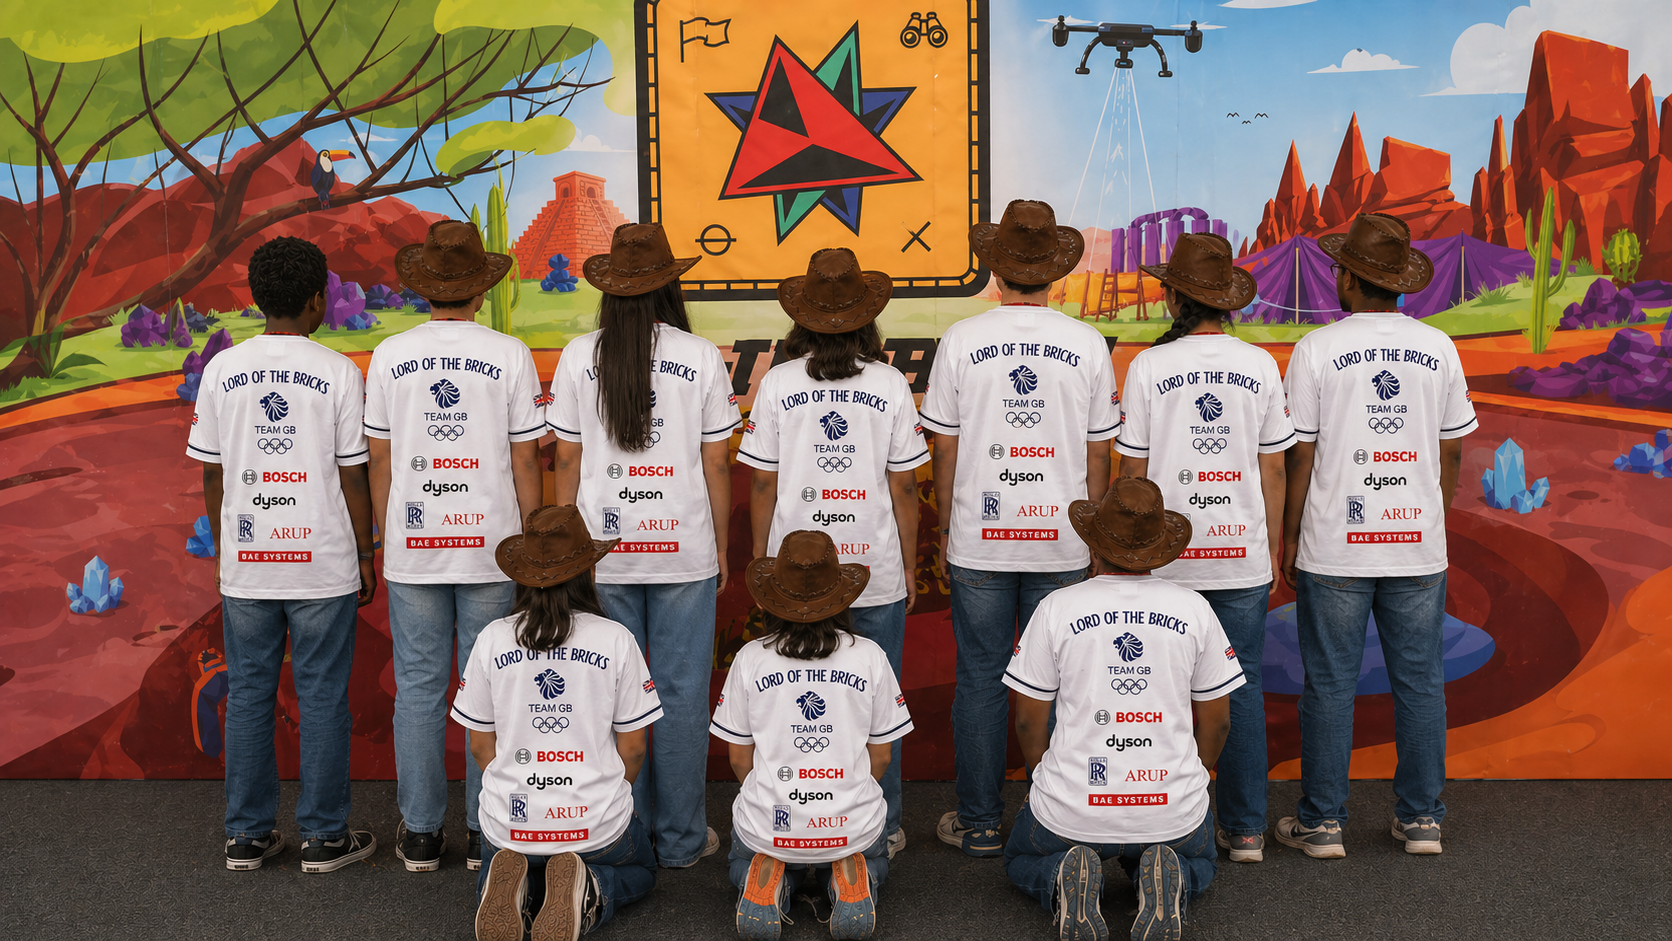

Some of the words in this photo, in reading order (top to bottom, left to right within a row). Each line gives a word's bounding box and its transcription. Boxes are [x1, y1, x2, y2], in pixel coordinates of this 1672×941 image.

[970, 345, 998, 365] LORD
[1002, 343, 1016, 356] OF
[1019, 343, 1040, 356] THE
[1043, 345, 1080, 367] BRICKS
[1333, 351, 1361, 371] LORD
[1364, 349, 1377, 362] OF
[1380, 348, 1400, 361] THE
[1403, 349, 1439, 371] BRICKS
[391, 360, 418, 380] LORD
[422, 357, 436, 370] OF
[440, 357, 461, 370] THE
[464, 358, 502, 380] BRICKS
[659, 360, 697, 382] BRICKS
[222, 372, 249, 393] LORD
[252, 370, 266, 384] OF
[269, 370, 290, 383] THE
[293, 371, 330, 394] BRICKS
[1156, 375, 1184, 395] LORD
[1187, 372, 1200, 385] OF
[1203, 371, 1224, 384] THE
[1227, 372, 1261, 394] BRICKS
[781, 392, 808, 411] LORD
[812, 390, 825, 403] OF
[829, 390, 850, 402] THE
[852, 391, 888, 412] BRICKS
[1003, 399, 1029, 408] TEAM
[1031, 399, 1045, 408] GB
[1366, 405, 1391, 413] TEAM
[1393, 405, 1407, 413] GB
[424, 412, 451, 421] TEAM
[454, 412, 468, 421] GB
[651, 418, 664, 427] GB
[254, 426, 280, 434] TEAM
[283, 426, 296, 434] GB
[1190, 426, 1214, 434] TEAM
[1217, 426, 1230, 434] GB
[814, 444, 839, 453] TEAM
[842, 445, 855, 453] GB
[1010, 446, 1055, 458] BOSCH
[1373, 451, 1417, 462] BOSCH
[433, 458, 479, 469] BOSCH
[263, 471, 307, 483] BOSCH
[629, 466, 674, 477] BOSCH
[999, 468, 1043, 486] dyson
[1198, 471, 1241, 482] BOSCH
[422, 479, 468, 497] dyson
[1364, 473, 1407, 491] dyson
[619, 487, 663, 503] dyson
[822, 489, 866, 500] BOSCH
[252, 493, 296, 510] dyson
[1189, 493, 1231, 509] dyson
[1017, 505, 1059, 517] ARUP
[1381, 508, 1422, 520] ARUP
[442, 513, 484, 525] ARUP
[812, 510, 855, 526] dyson
[637, 519, 679, 531] ARUP
[1207, 525, 1246, 536] ARUP
[270, 527, 312, 539] ARUP
[613, 544, 625, 552] AE
[1179, 550, 1195, 558] AE
[1070, 614, 1100, 635] LORD
[1104, 611, 1118, 625] OF
[1122, 611, 1144, 624] THE
[1148, 612, 1188, 635] BRICKS
[494, 649, 523, 670] LORD
[570, 648, 610, 670] BRICKS
[1108, 666, 1134, 675] TEAM
[1136, 666, 1151, 675] GB
[755, 672, 784, 692] LORD
[787, 669, 802, 683] OF
[805, 669, 827, 682] THE
[830, 670, 867, 692] BRICKS
[528, 704, 556, 713] TEAM
[558, 704, 572, 713] GB
[1116, 711, 1162, 723] BOSCH
[791, 725, 817, 733] TEAM
[819, 724, 833, 733] GB
[1106, 734, 1152, 752] dyson
[537, 750, 584, 762] BOSCH
[799, 768, 844, 779] BOSCH
[1125, 769, 1168, 782] ARUP
[527, 773, 572, 790] dyson
[789, 788, 833, 805] dyson
[545, 806, 588, 819] ARUP
[807, 816, 848, 828] ARUP
